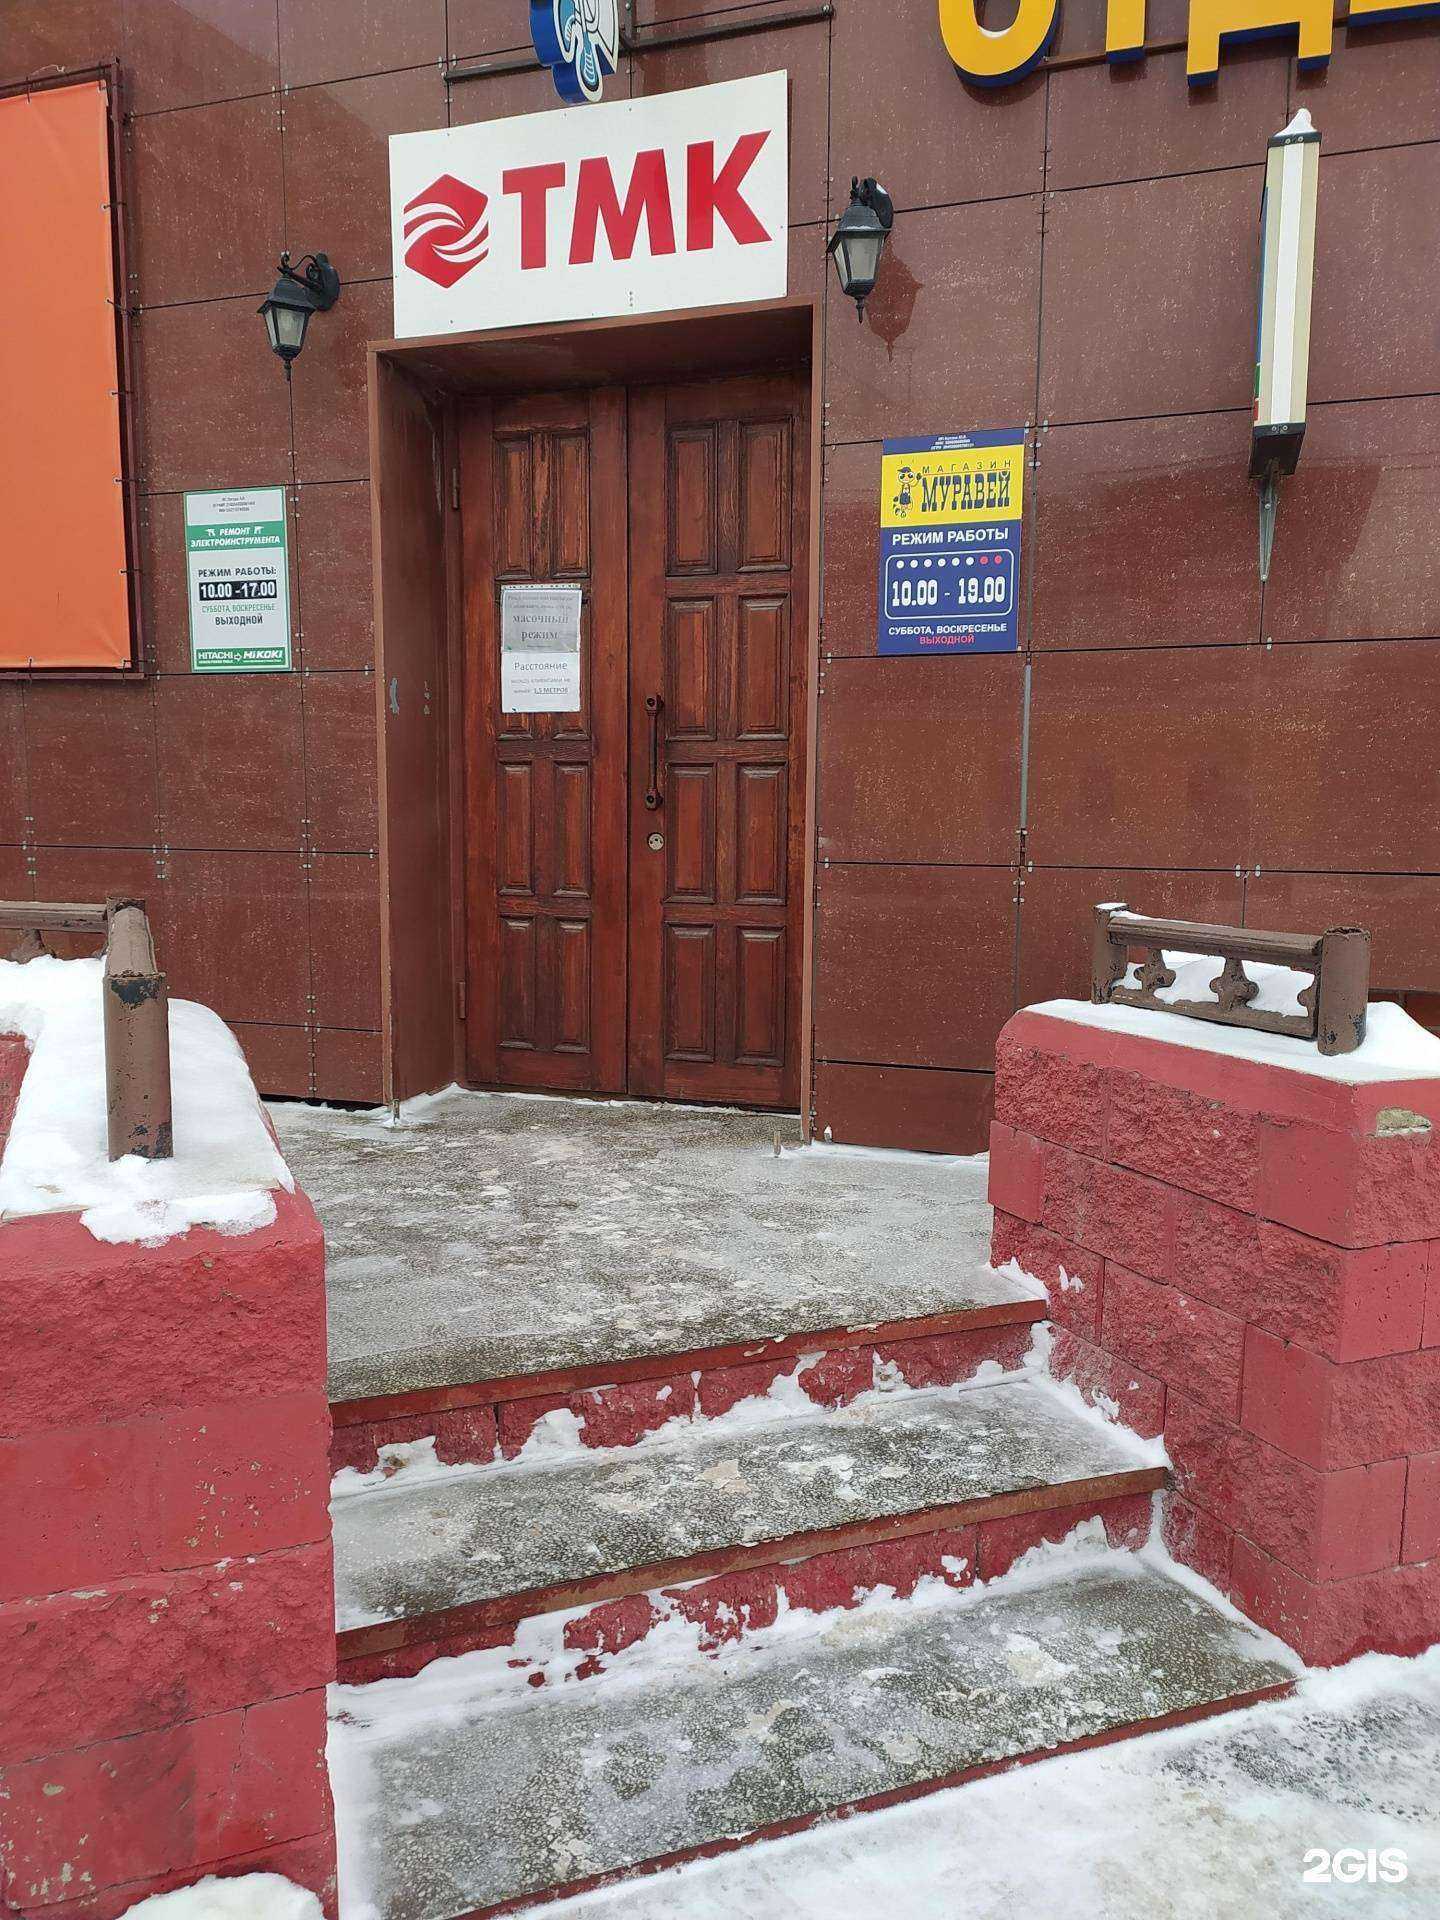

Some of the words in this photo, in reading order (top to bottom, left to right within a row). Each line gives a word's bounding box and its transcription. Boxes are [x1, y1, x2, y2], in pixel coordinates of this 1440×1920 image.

[502, 130, 772, 270] ТМК
[922, 460, 1011, 474] МАГАЗИН
[921, 471, 1011, 512] МУРАВЕЙ
[219, 527, 251, 537] РЕМОНТ
[892, 531, 944, 545] РЕЖИМ
[947, 528, 1009, 542] РАБОТЫ
[190, 536, 281, 548] ЭЛЕКТРОИНСТРУМЕНТА
[198, 568, 232, 578] РЕЖИМ
[235, 566, 277, 576] РАБОТЫ:
[200, 583, 232, 599] 10.00
[892, 579, 938, 607] 10.00
[958, 576, 1006, 604] 19.00
[232, 602, 275, 612] ВОСКРЕСЕНЬЕ
[215, 614, 263, 626] ВЫХОДНОЙ
[888, 625, 934, 636] СУББОТА,
[936, 622, 1007, 634] ВОСКРЕСЕНЬЕ
[521, 631, 560, 641] режим
[919, 634, 975, 645] ВЫХОДНОЙ
[198, 651, 234, 660] HITACHI
[514, 662, 568, 671] Расстояние
